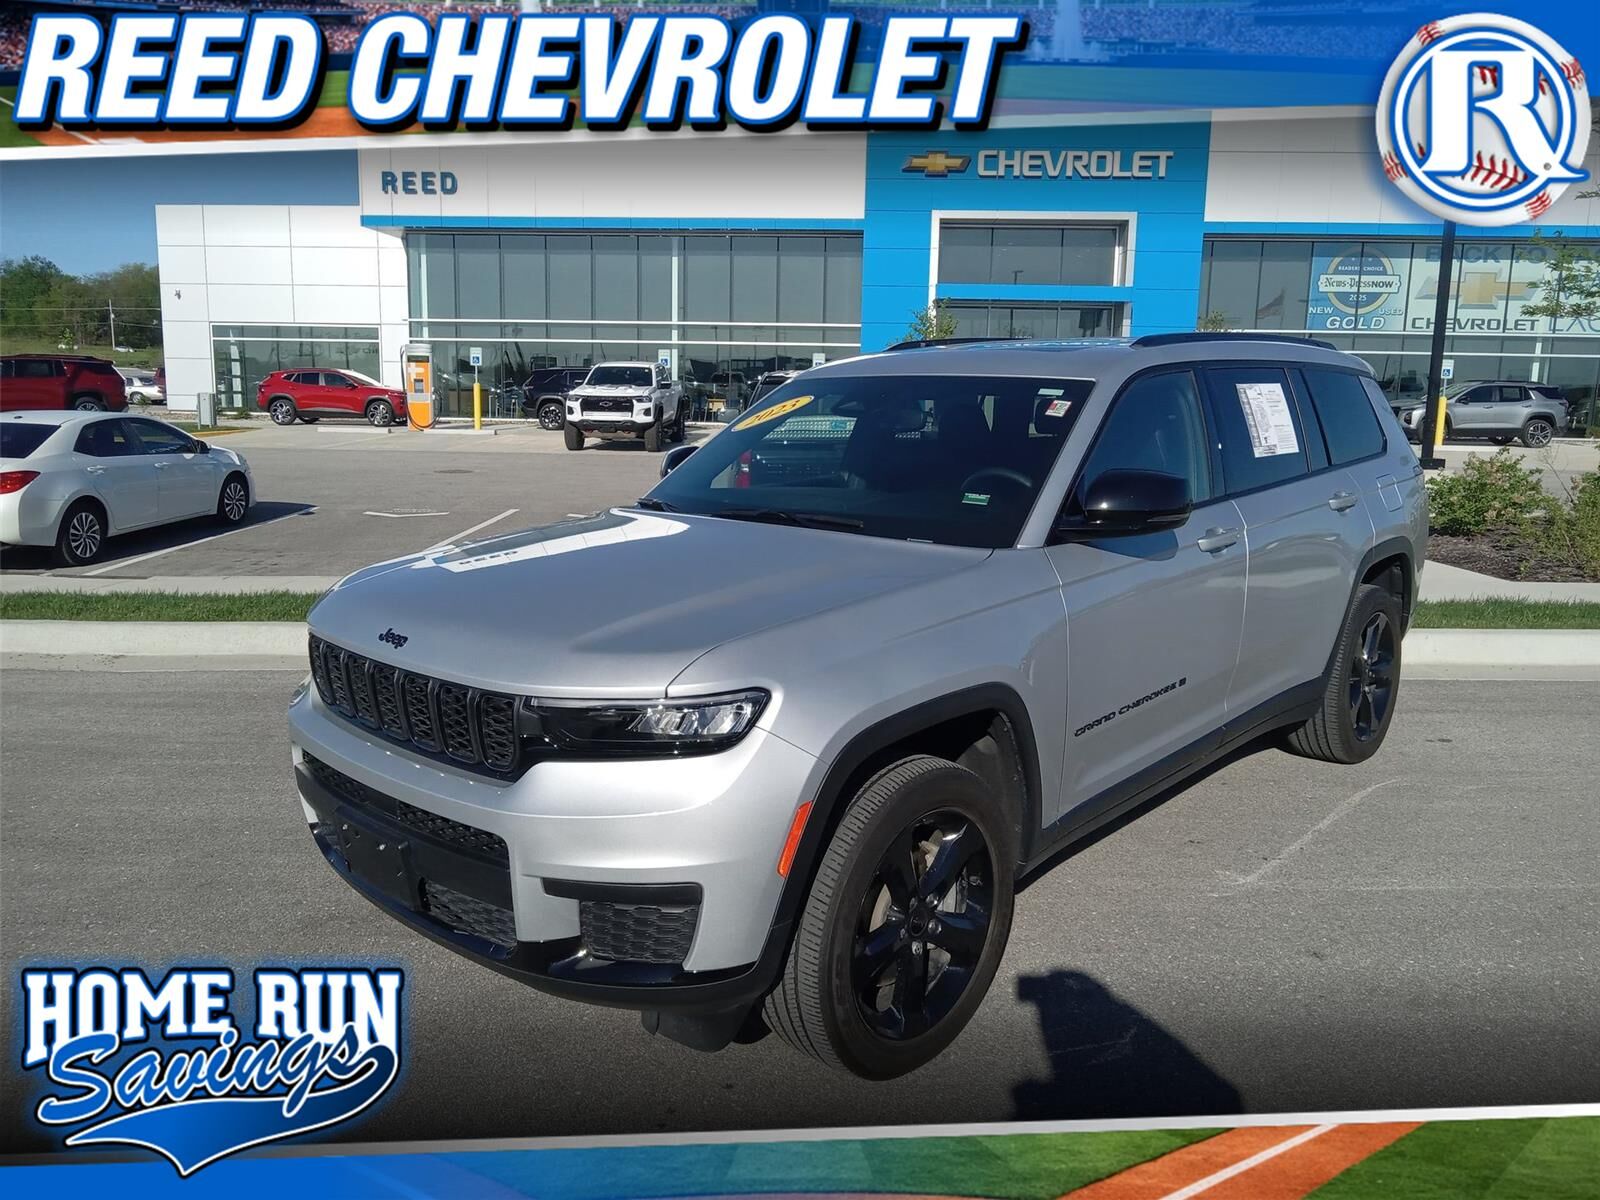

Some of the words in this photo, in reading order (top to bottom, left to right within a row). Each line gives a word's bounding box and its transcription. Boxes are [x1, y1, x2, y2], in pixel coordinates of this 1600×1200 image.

[977, 149, 1174, 179] CHEVROLET
[381, 171, 458, 195] REED
[1308, 306, 1334, 314] NEW
[1378, 308, 1403, 316] USED
[1326, 316, 1385, 330] GOLD
[743, 398, 801, 427] 2023
[378, 628, 409, 649] Jeep
[1074, 711, 1117, 737] GRAND
[1118, 682, 1177, 715] CHEROKEE
